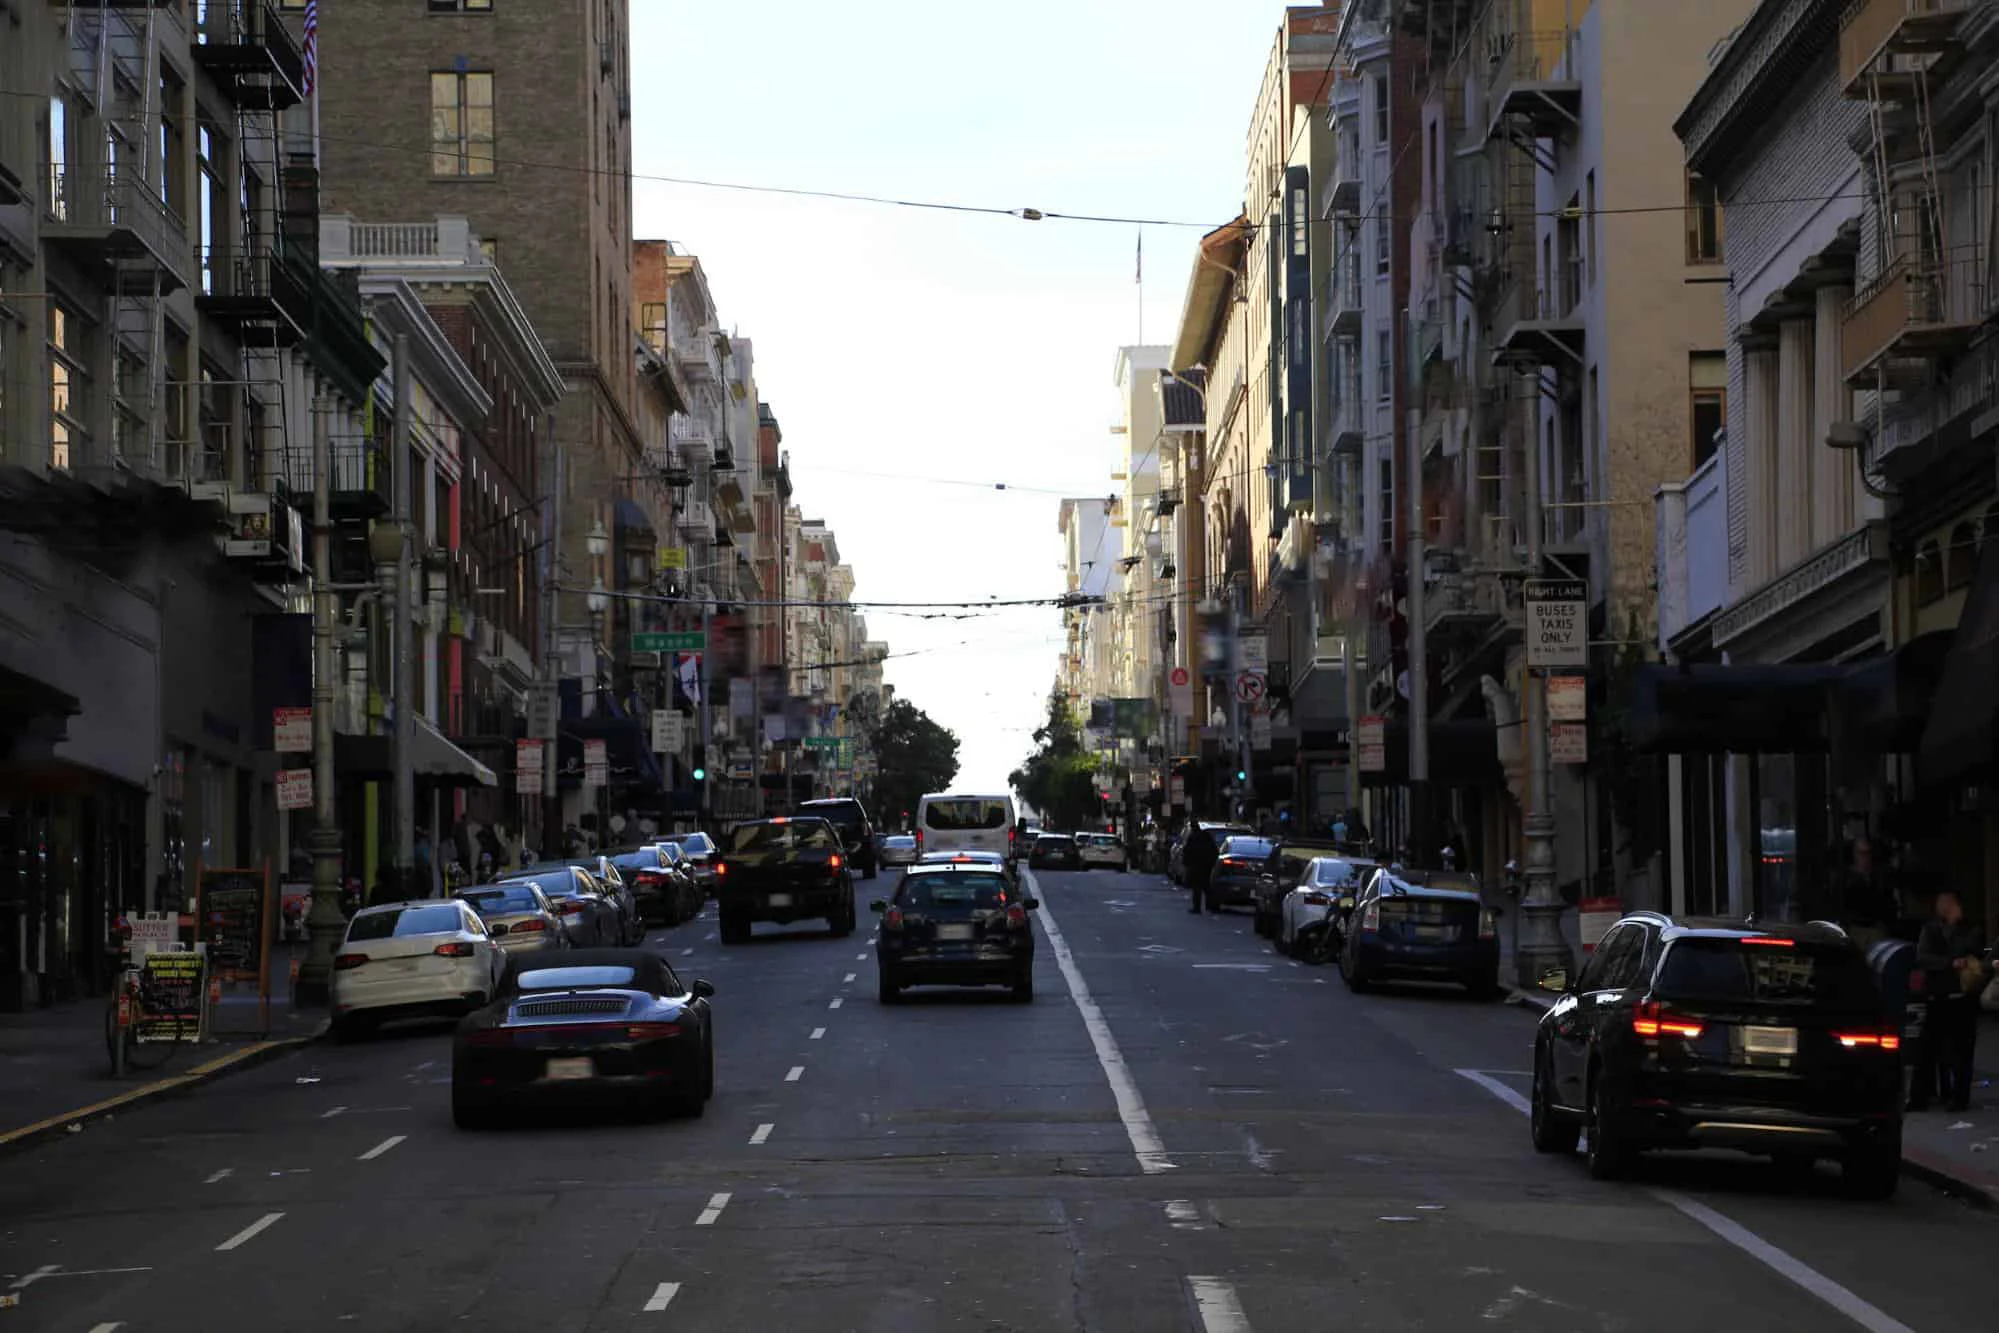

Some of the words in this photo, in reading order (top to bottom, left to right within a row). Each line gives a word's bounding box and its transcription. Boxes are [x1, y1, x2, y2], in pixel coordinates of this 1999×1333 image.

[1558, 586, 1585, 598] LANE
[1536, 604, 1576, 617] BUSES
[1541, 619, 1573, 630] TAXIS
[1541, 632, 1572, 644] ONLY
